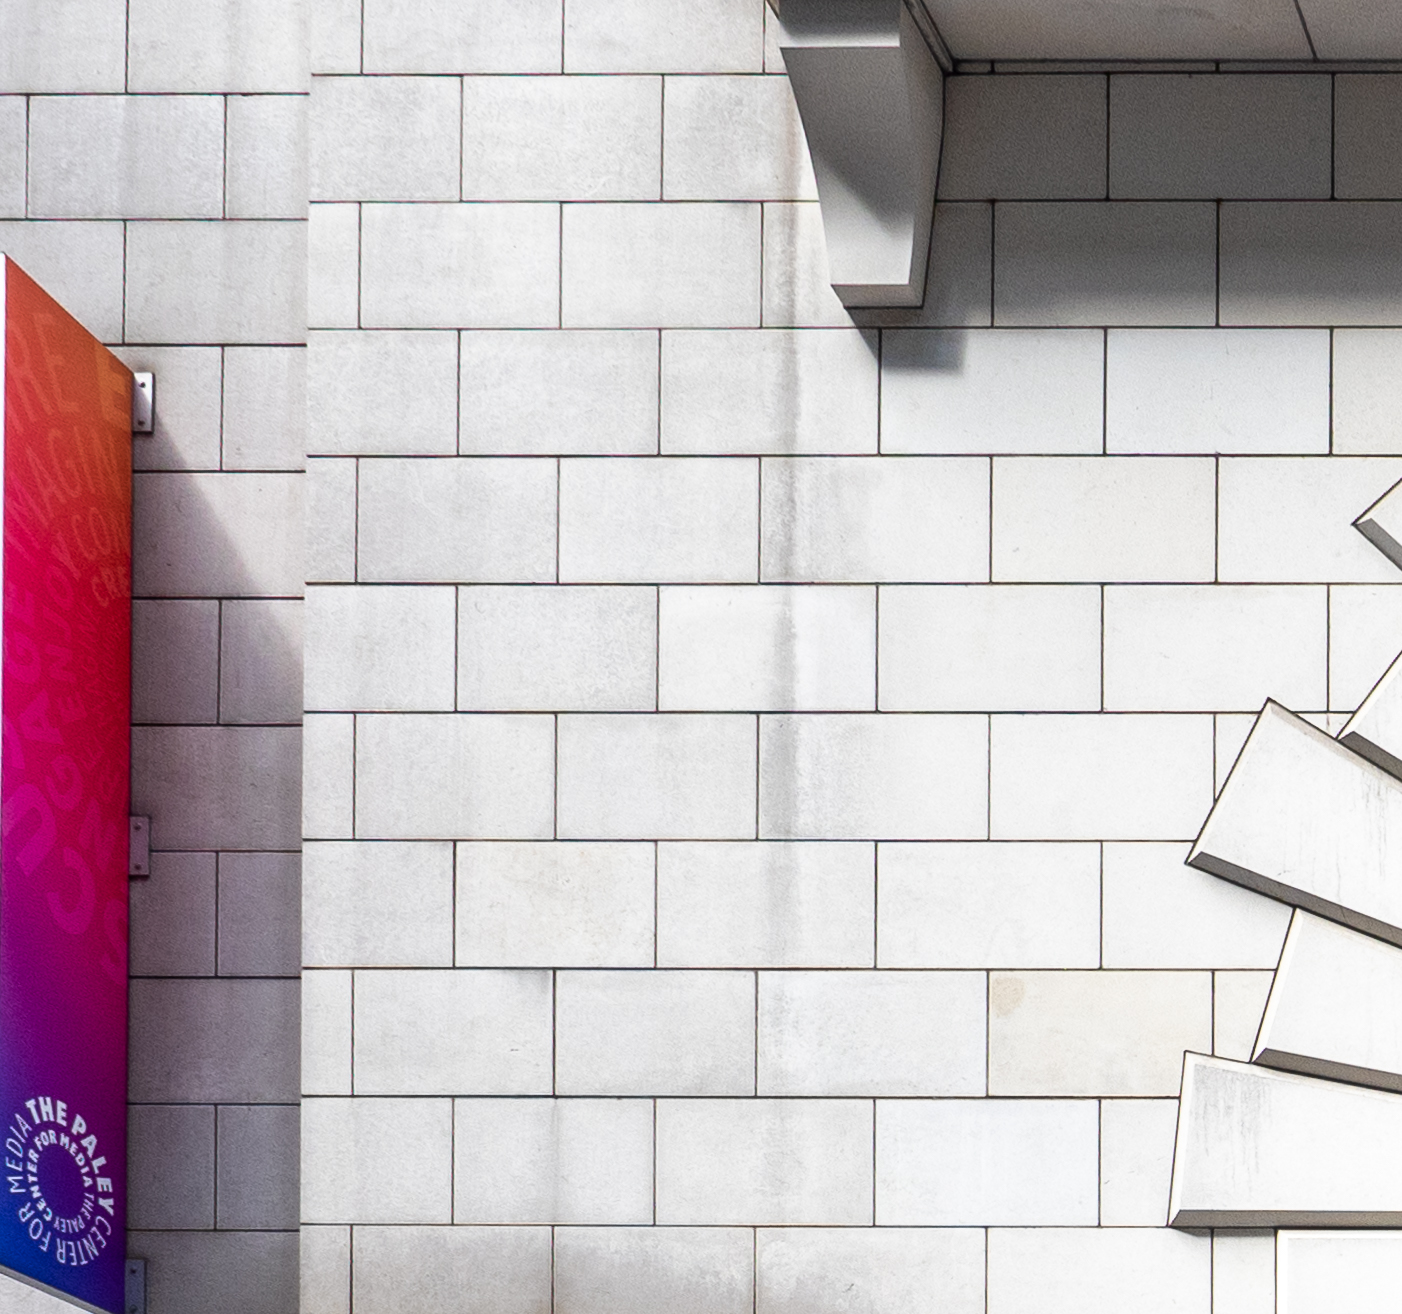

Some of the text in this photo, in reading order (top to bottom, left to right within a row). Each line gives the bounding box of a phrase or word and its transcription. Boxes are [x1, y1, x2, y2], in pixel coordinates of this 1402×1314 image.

[33, 1128, 58, 1151] FOR
[59, 1131, 93, 1188] MEDIA
[5, 1096, 115, 1266] THE PALEY CENTER FOR MEDIA
[26, 1148, 53, 1222] CENTER
